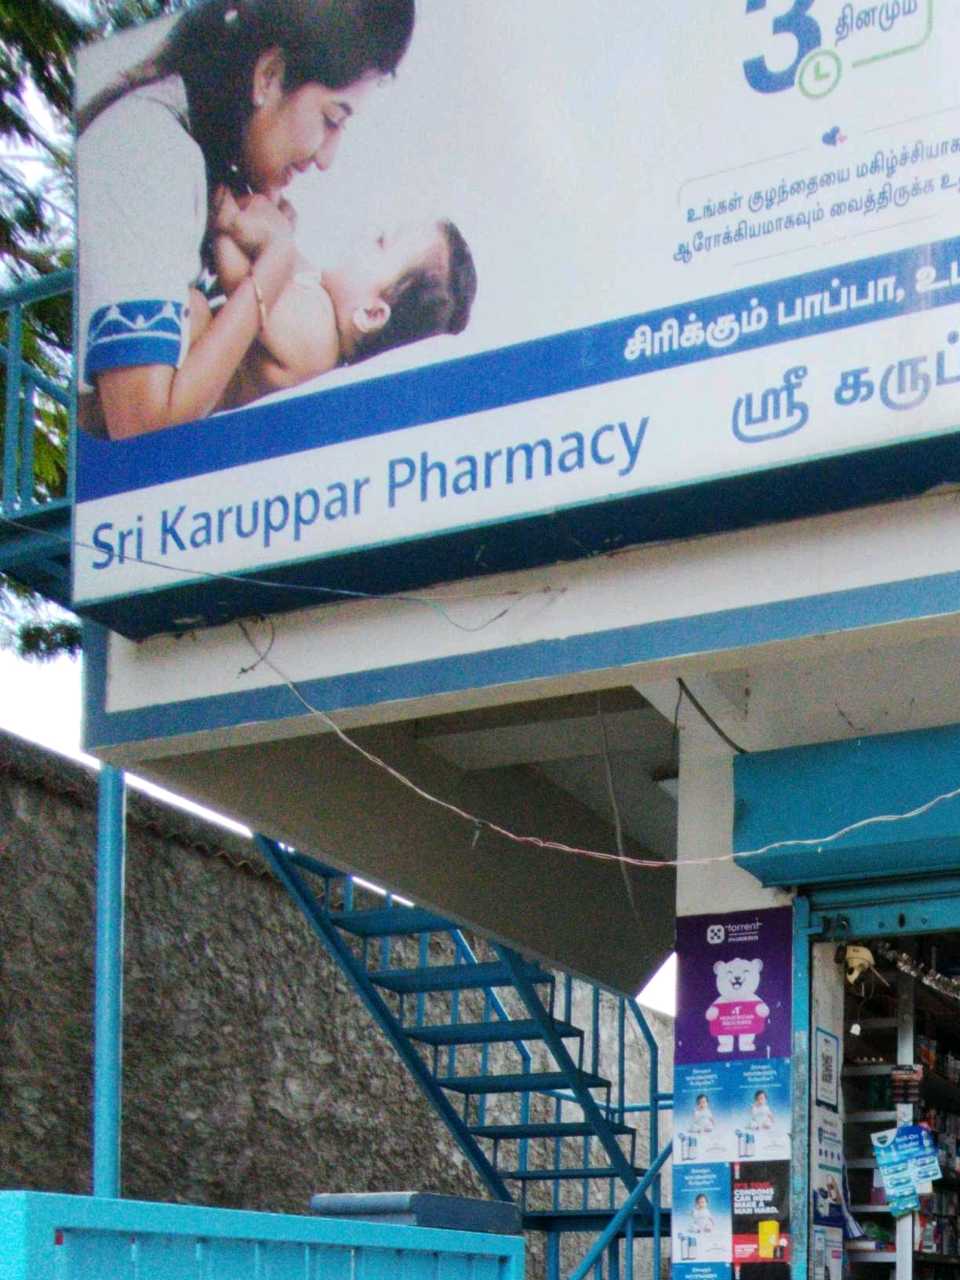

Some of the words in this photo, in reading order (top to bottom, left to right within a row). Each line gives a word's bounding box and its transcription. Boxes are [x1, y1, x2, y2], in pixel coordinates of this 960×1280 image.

[687, 191, 744, 223] உங்கள்
[748, 168, 850, 214] குழந்தையை
[623, 298, 769, 361] சிரிக்கும்
[777, 277, 906, 326] பாப்பா,
[91, 515, 143, 570] Sri
[160, 476, 371, 555] Karuppar
[387, 415, 650, 508] Pharmacy
